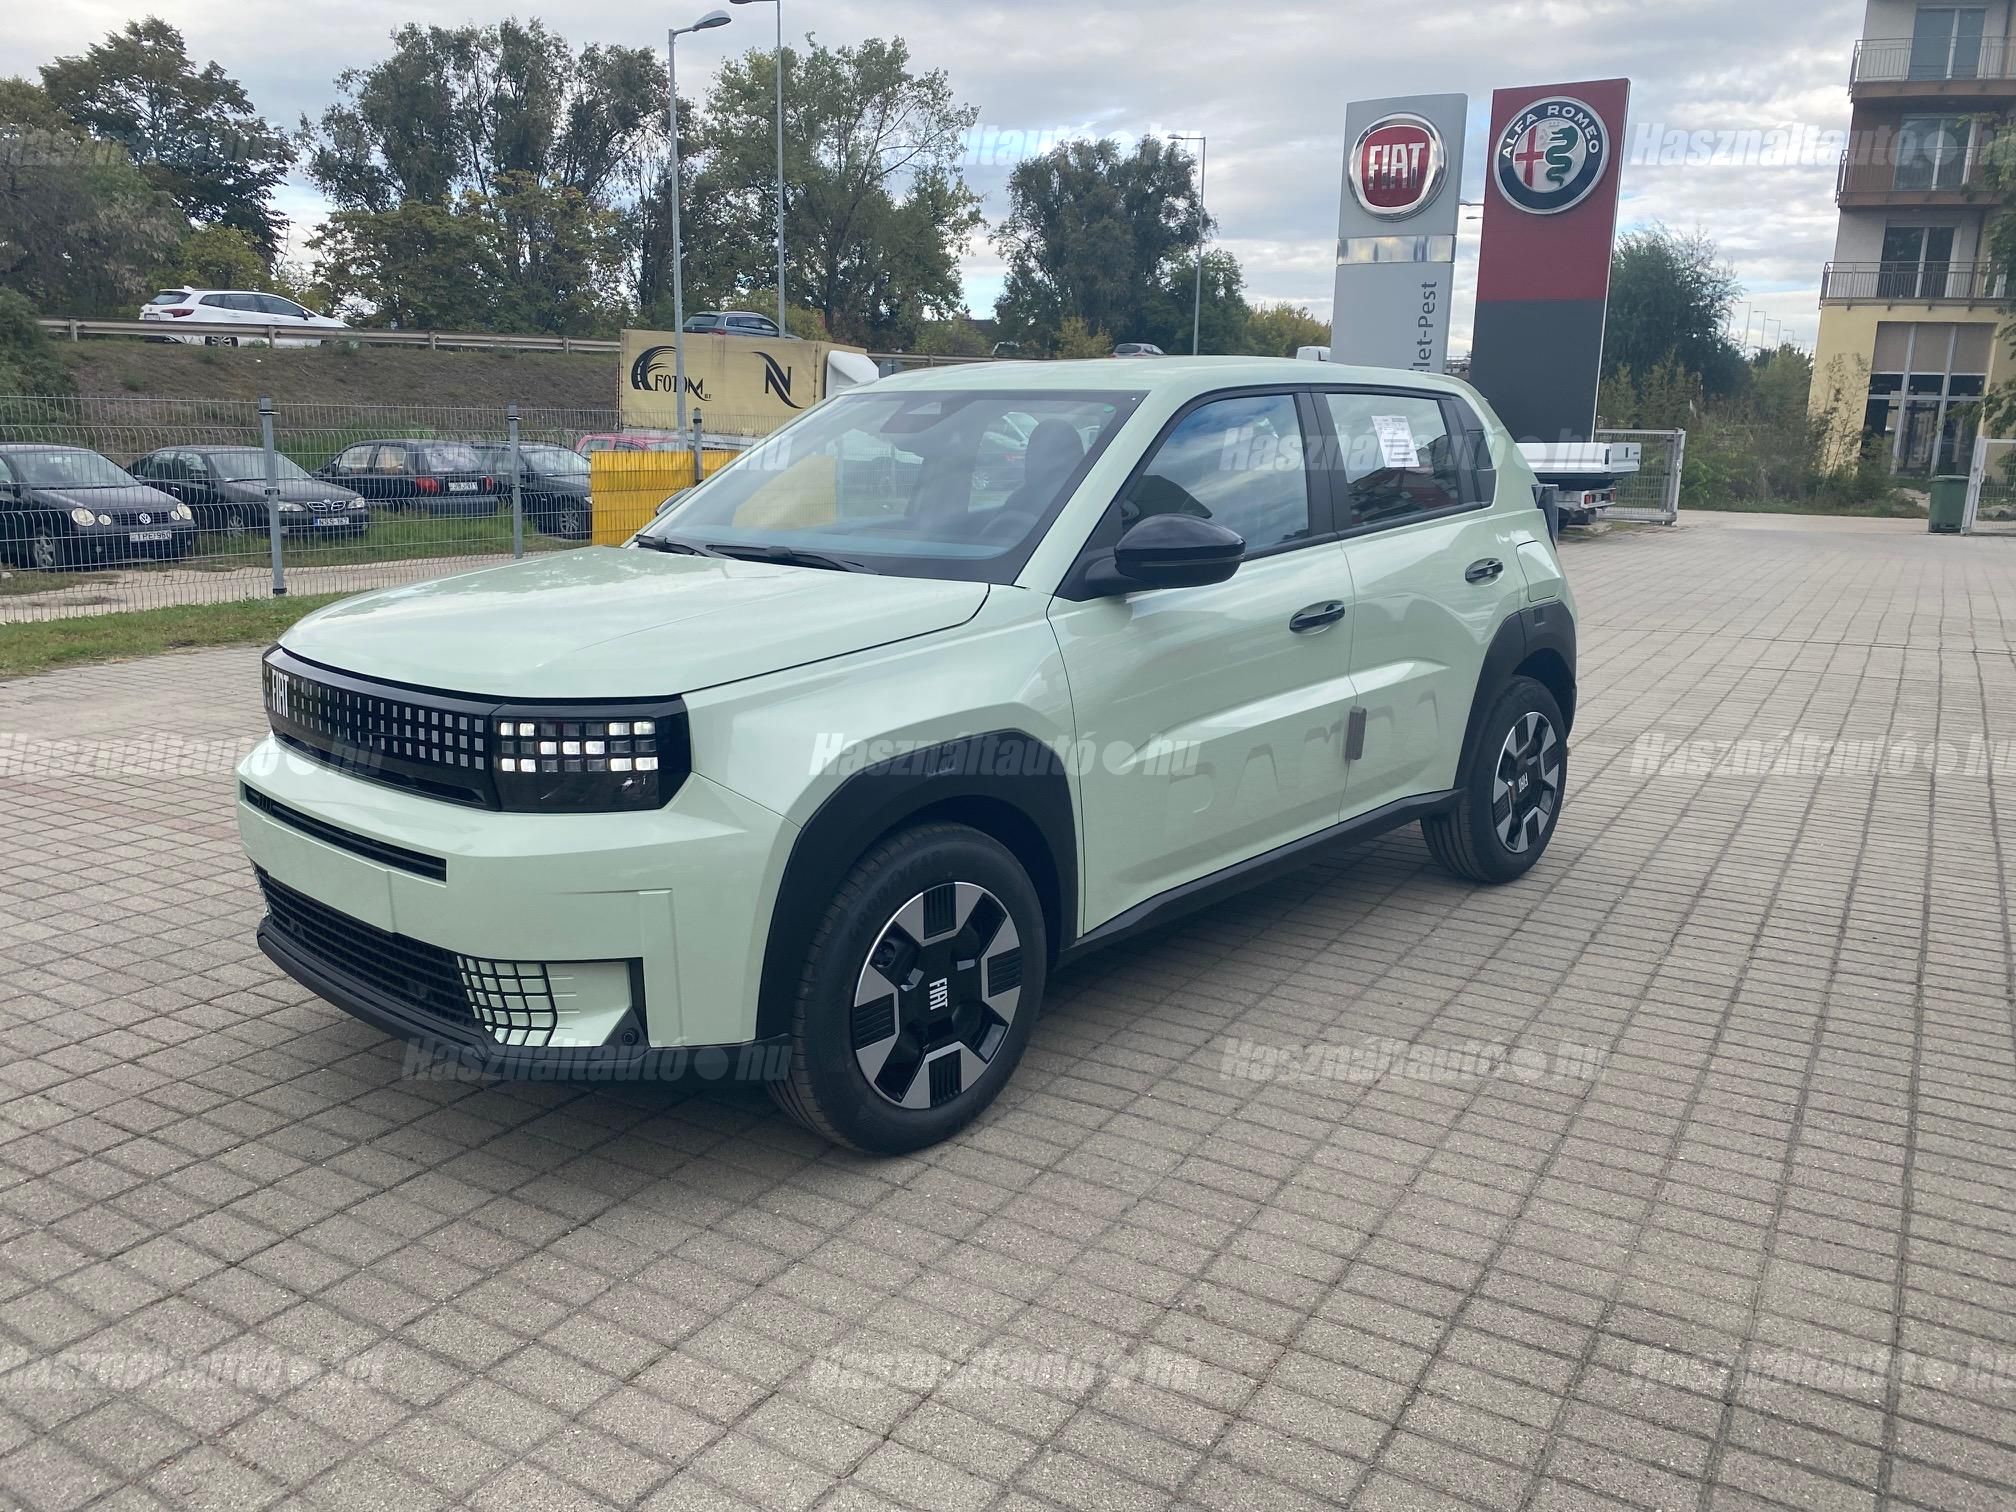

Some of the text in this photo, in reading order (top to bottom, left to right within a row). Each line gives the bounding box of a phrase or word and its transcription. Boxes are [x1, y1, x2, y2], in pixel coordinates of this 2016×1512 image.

[1502, 104, 1600, 159] ALFA ROMEO
[1367, 142, 1426, 191] FIAT
[1410, 281, 1437, 372] let-Pest
[271, 669, 290, 718] FIAT
[930, 978, 947, 1010] FIAT
